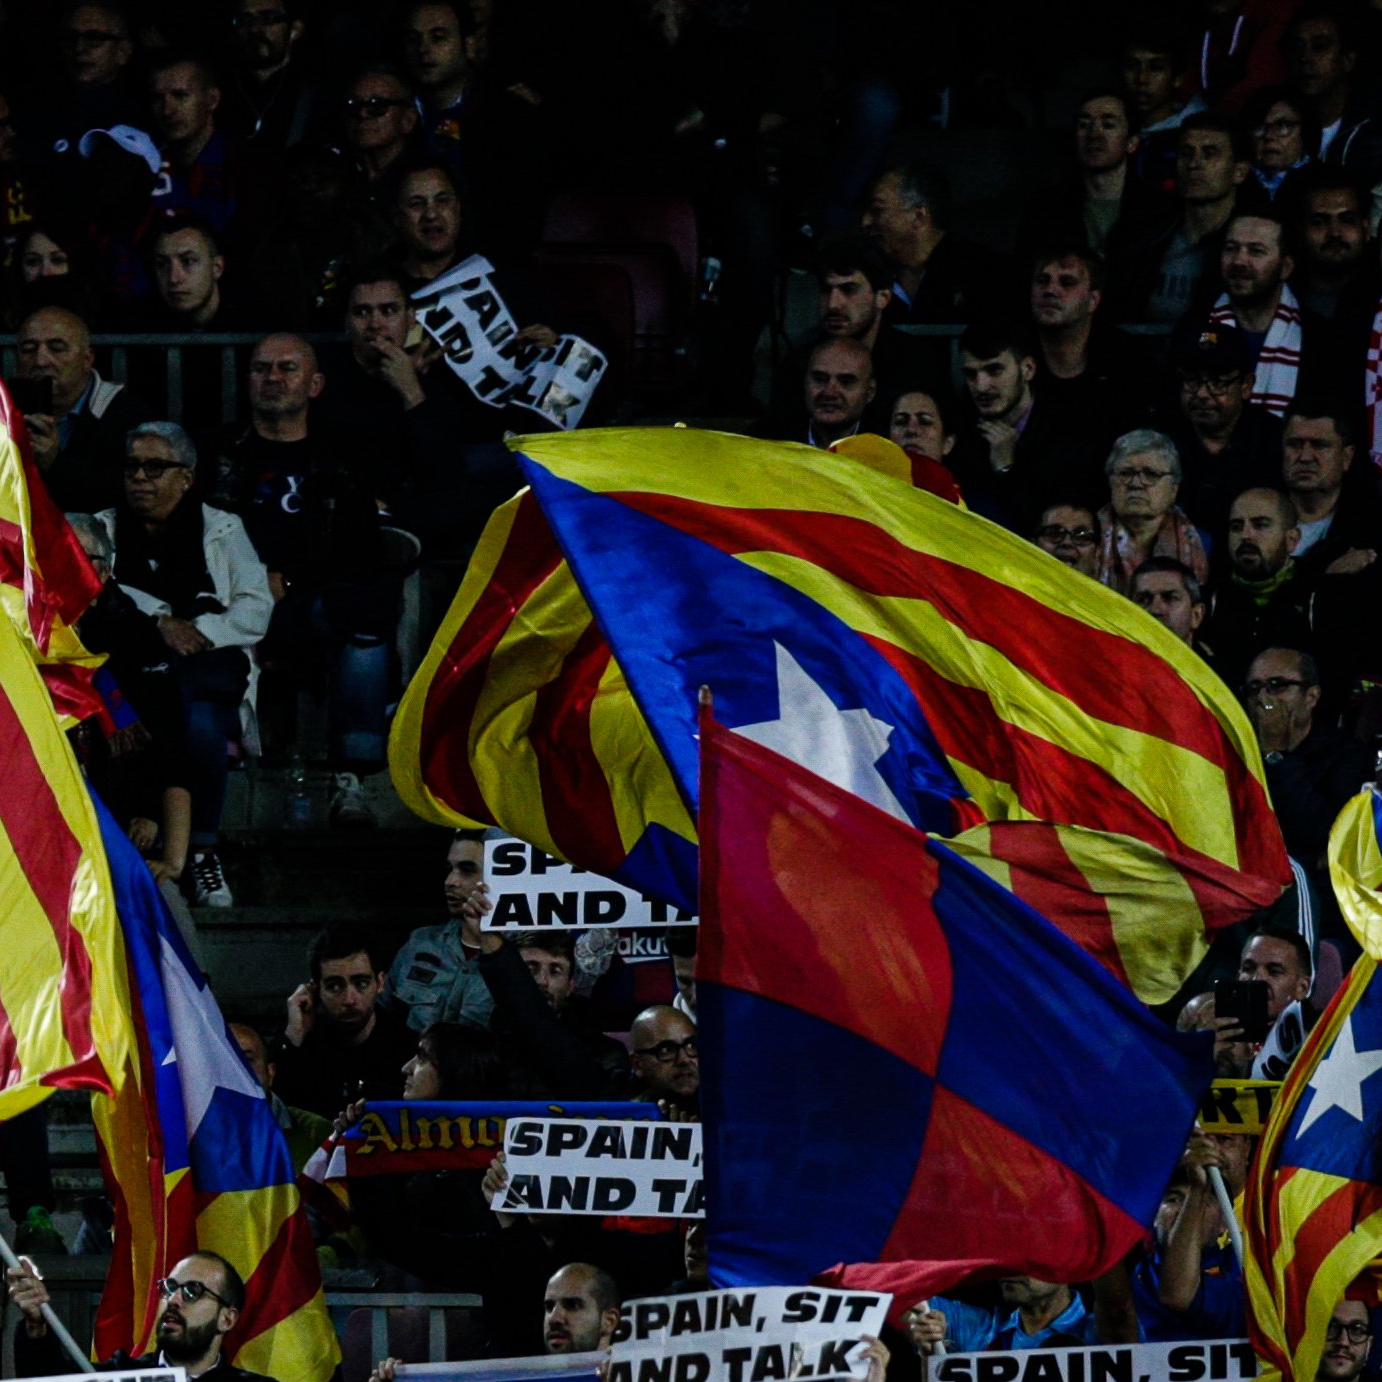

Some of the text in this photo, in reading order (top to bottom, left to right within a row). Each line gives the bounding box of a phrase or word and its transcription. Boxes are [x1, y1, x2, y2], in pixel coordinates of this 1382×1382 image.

[490, 891, 627, 927] AND
[502, 1174, 636, 1213] AND
[614, 1294, 880, 1344] SPAIN, SIT
